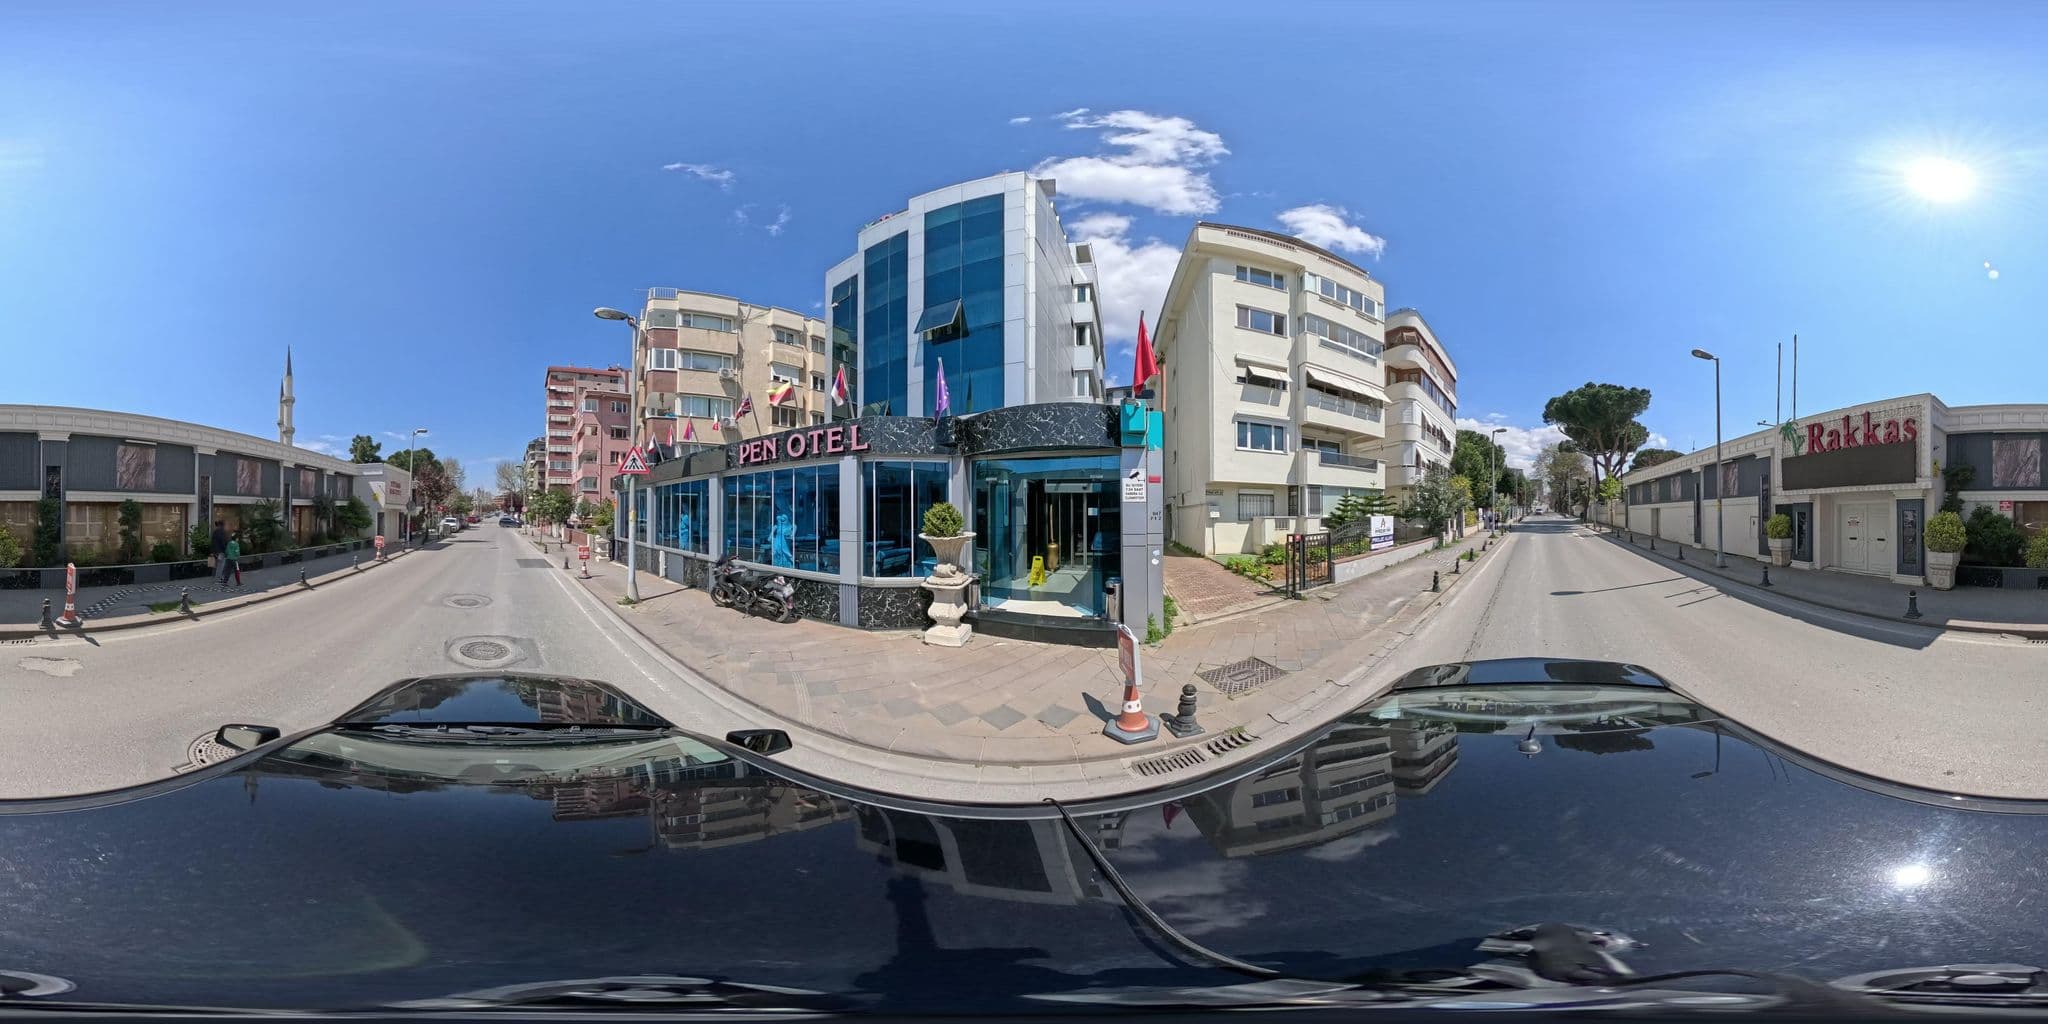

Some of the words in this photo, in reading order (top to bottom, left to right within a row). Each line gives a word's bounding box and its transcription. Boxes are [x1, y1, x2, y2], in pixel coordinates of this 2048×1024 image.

[739, 437, 777, 465] PEN
[786, 424, 868, 458] OTEL
[1805, 411, 1917, 455] Rakkas
